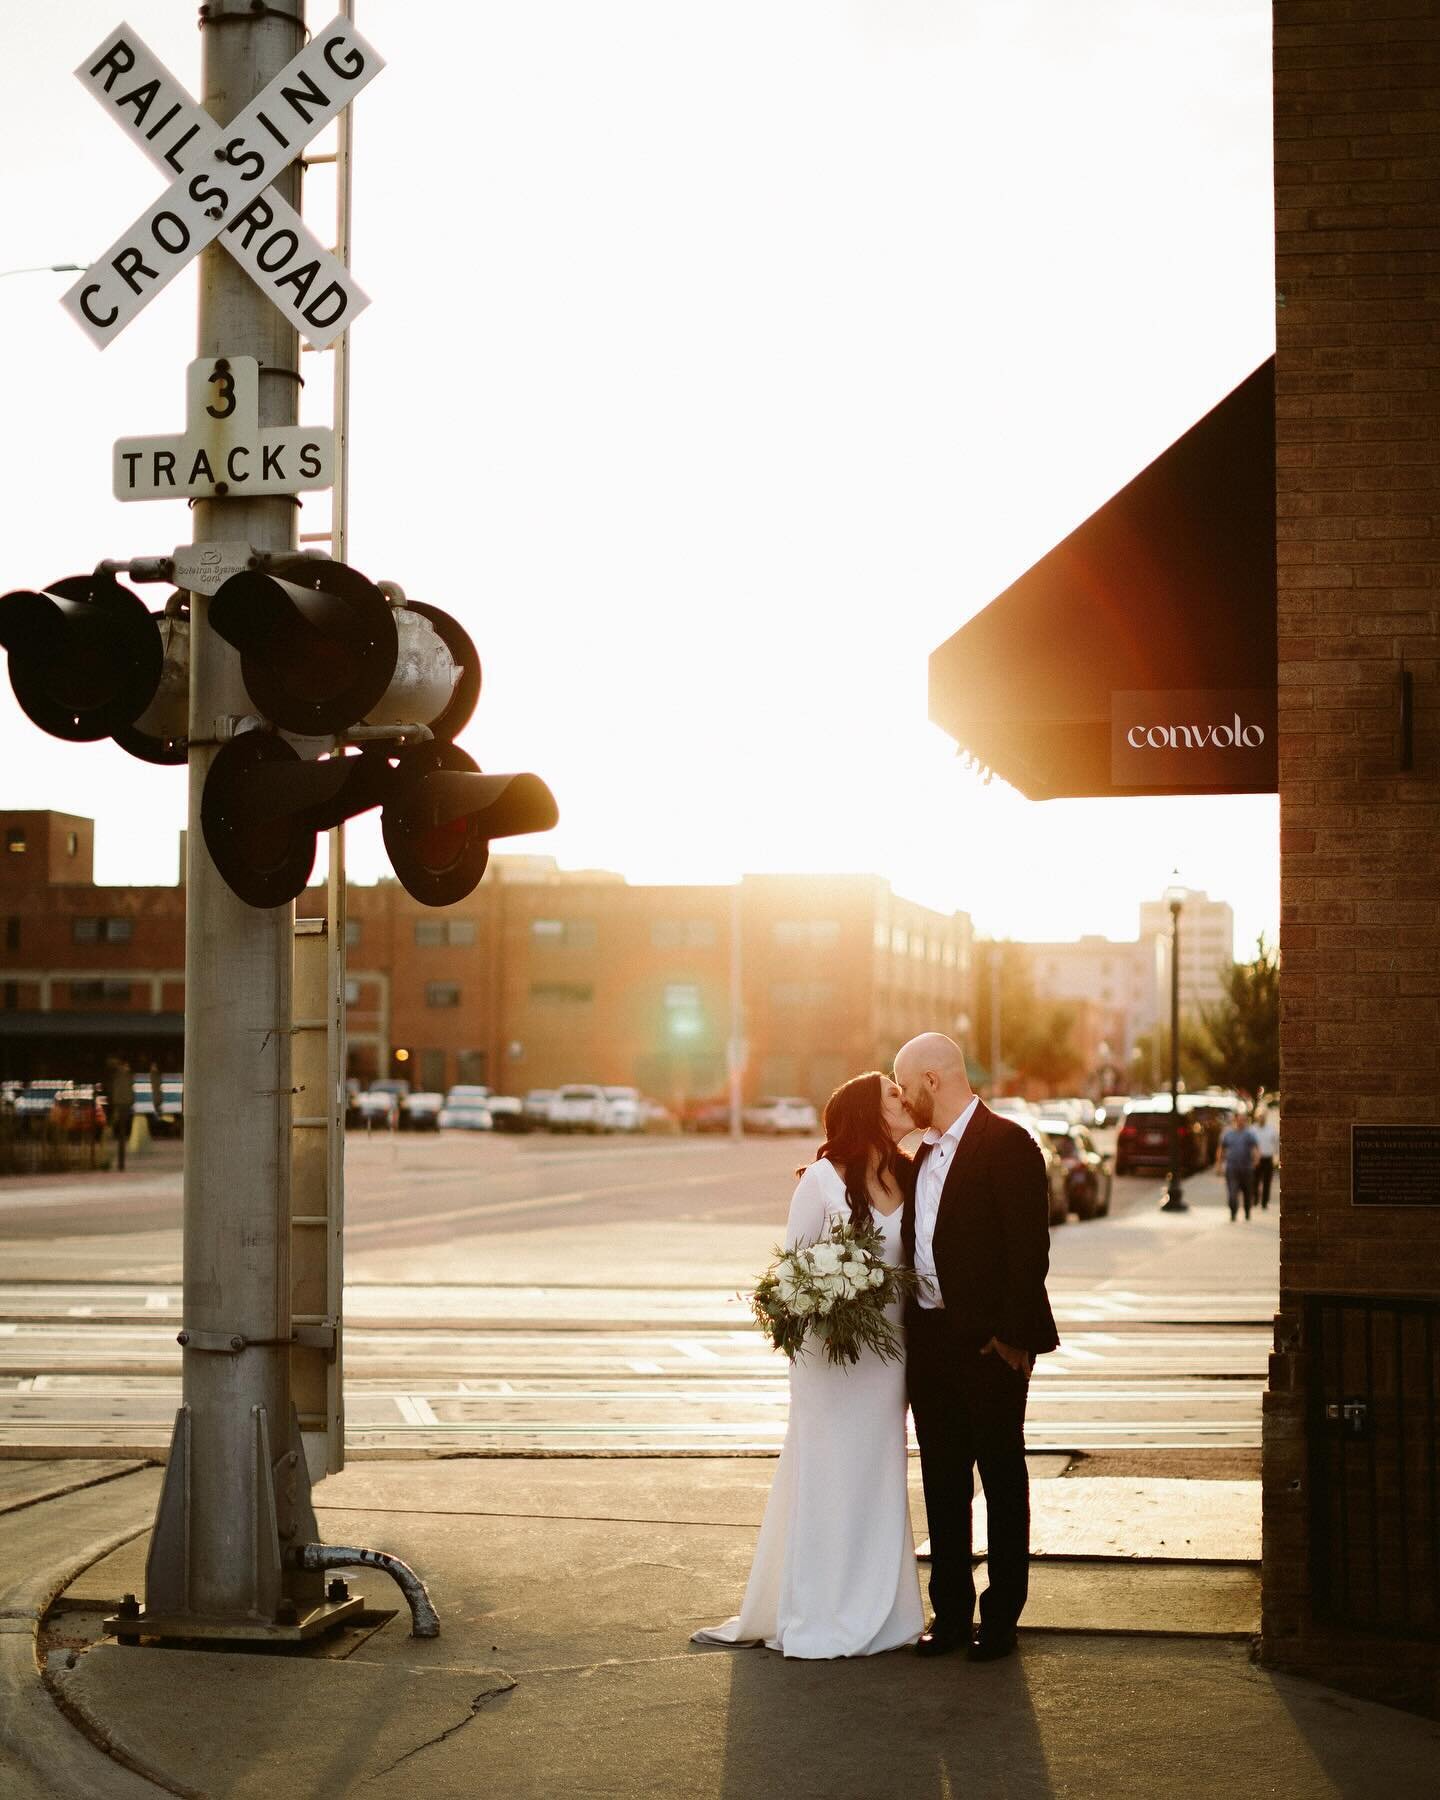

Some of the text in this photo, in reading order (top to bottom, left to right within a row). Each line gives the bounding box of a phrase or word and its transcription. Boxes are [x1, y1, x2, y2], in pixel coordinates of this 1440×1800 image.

[80, 36, 365, 328] CROSSING
[206, 370, 236, 419] 3
[122, 443, 322, 488] TRACKS
[1127, 712, 1265, 748] convolo
